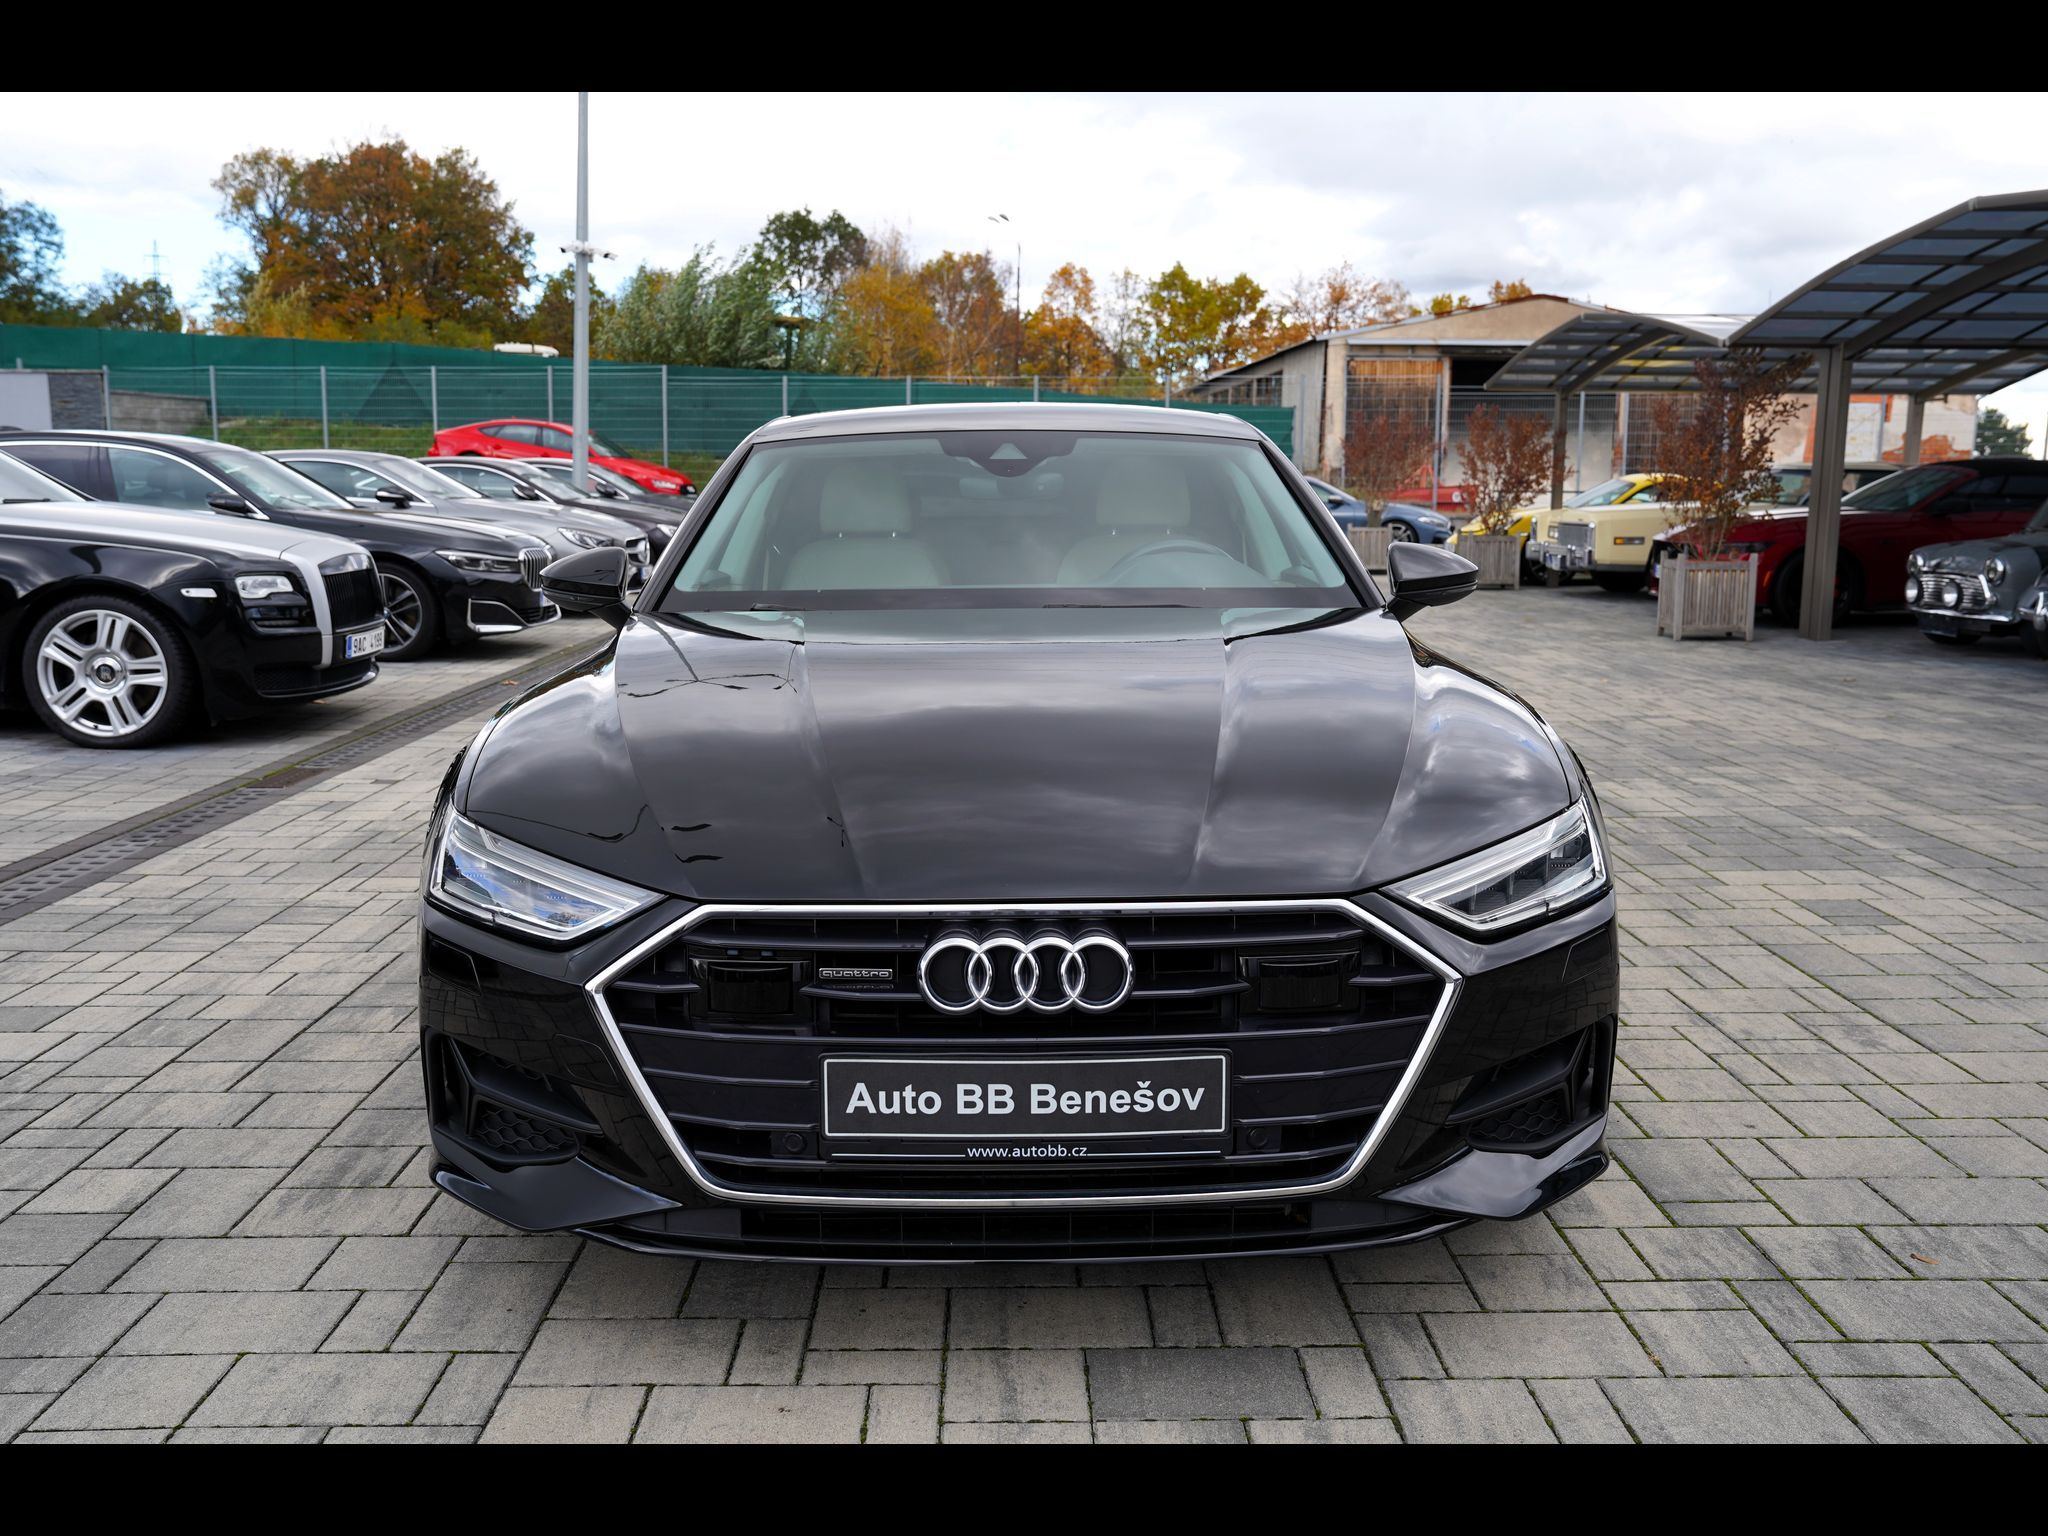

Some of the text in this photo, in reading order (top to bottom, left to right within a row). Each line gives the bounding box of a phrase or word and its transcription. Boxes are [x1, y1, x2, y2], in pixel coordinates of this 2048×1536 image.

[822, 970, 889, 978] quattro
[846, 1081, 1206, 1115] Auto BB Benešov
[967, 1144, 1087, 1158] www.autobb.cz
